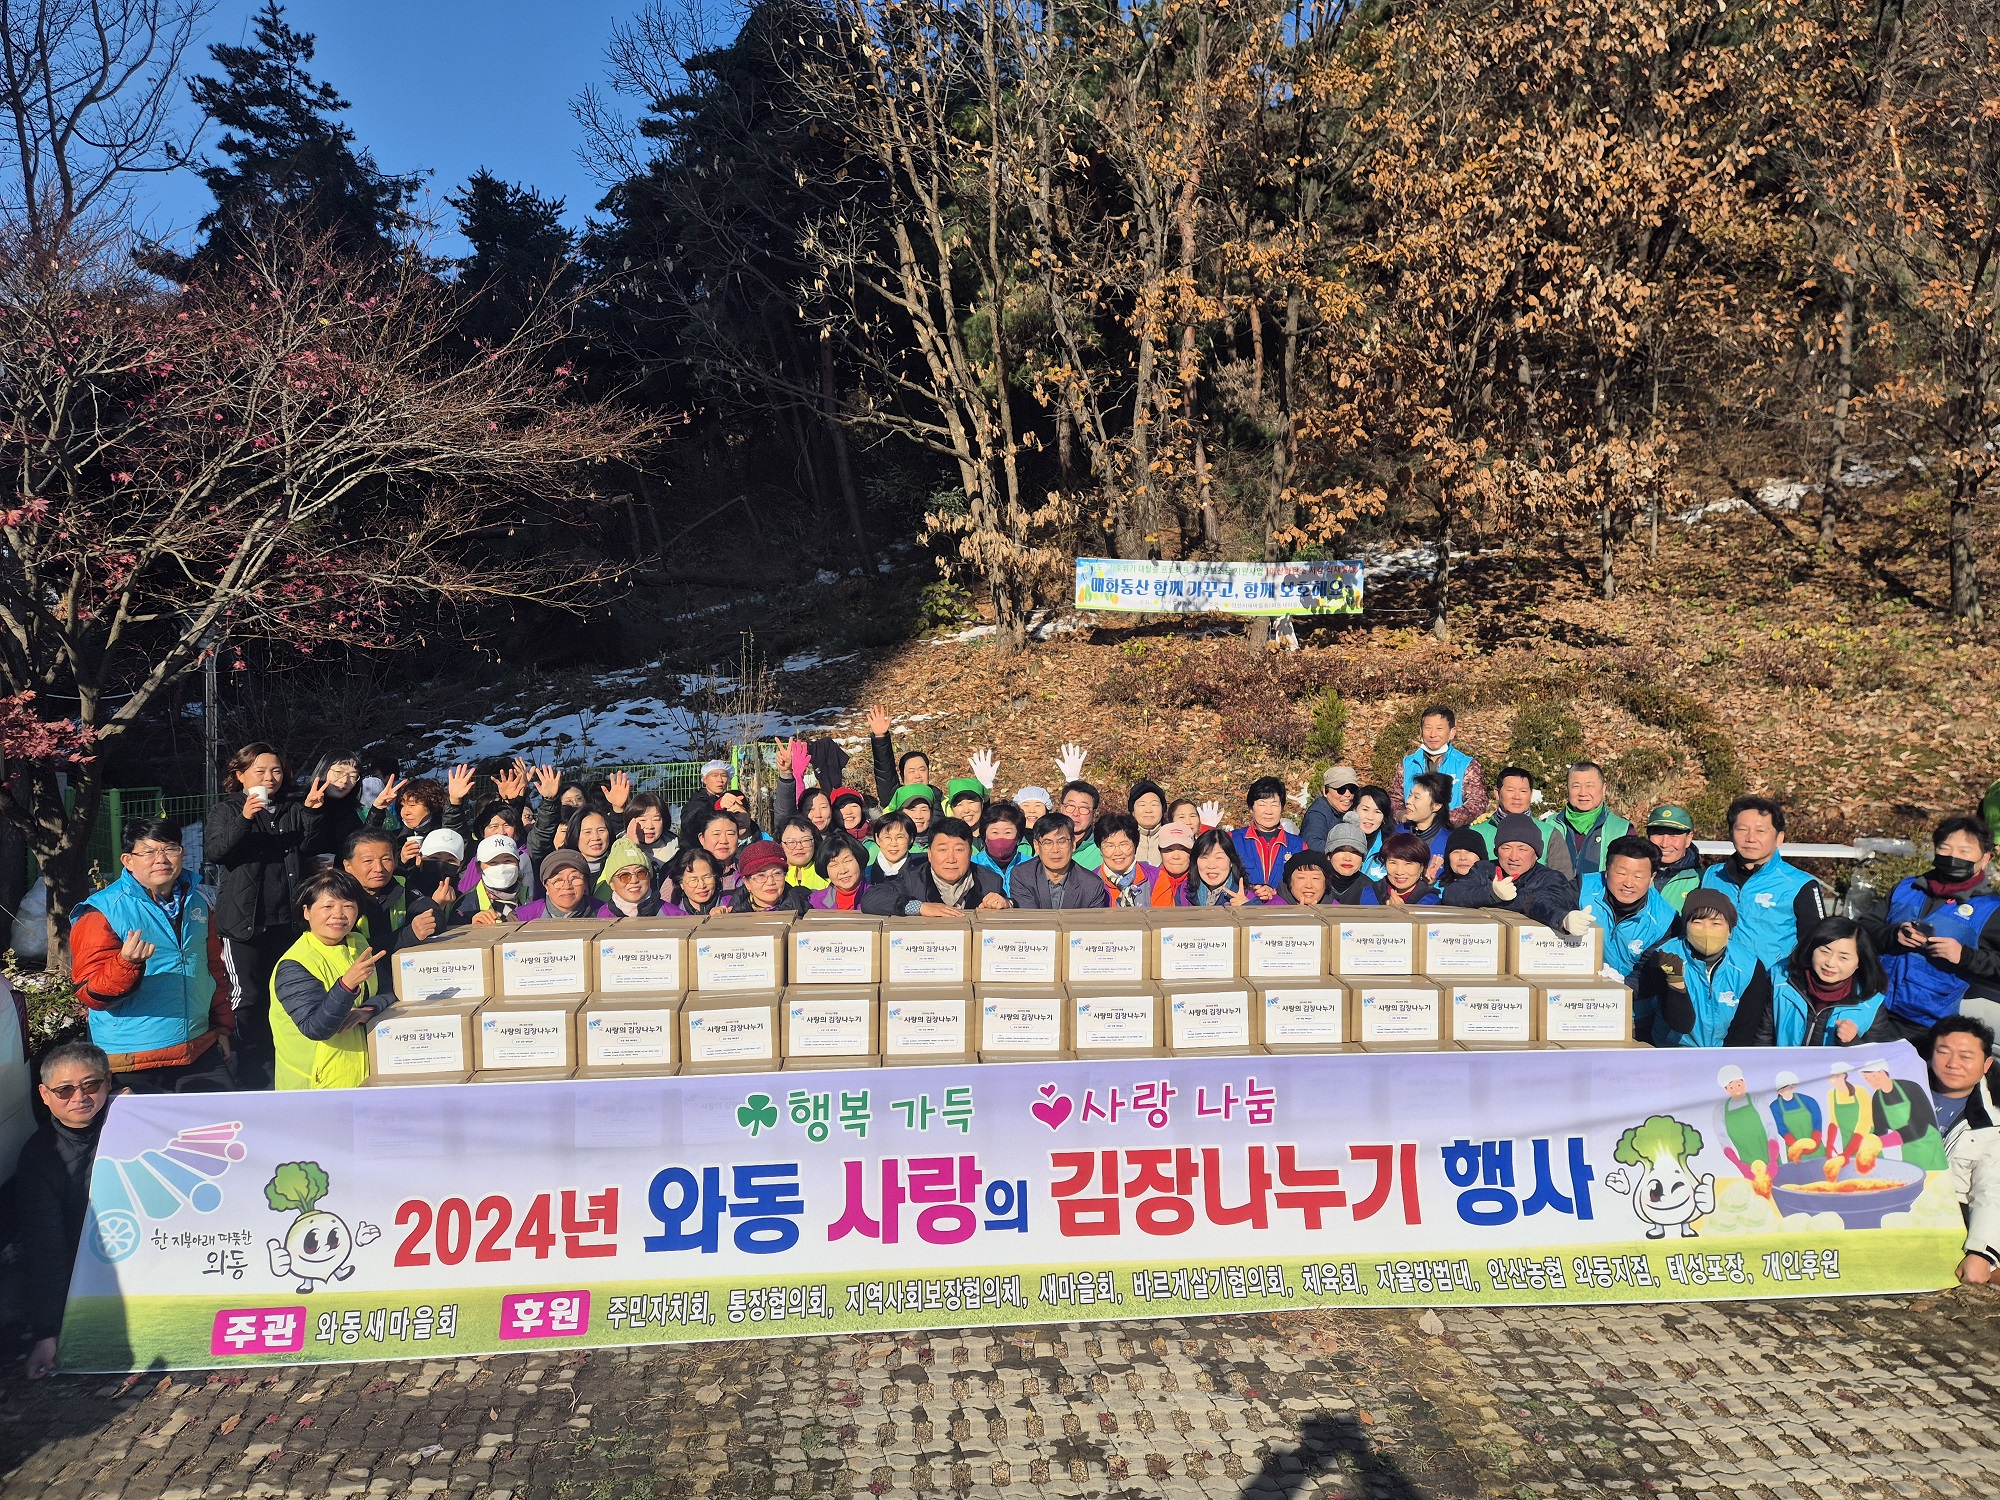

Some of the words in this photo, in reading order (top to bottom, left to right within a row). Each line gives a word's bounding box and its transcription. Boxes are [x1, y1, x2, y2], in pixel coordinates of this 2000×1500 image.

[1090, 577, 1150, 596] 매화동산
[1154, 580, 1183, 597] 함께
[1188, 580, 1238, 599] 가꾸고,
[1244, 581, 1275, 599] 함께
[788, 1090, 872, 1142] 행복
[891, 1087, 973, 1133] 가득
[1081, 1082, 1175, 1129] 사랑
[1197, 1079, 1275, 1124] 나눔
[394, 1188, 618, 1267] 2024년
[644, 1164, 803, 1254] 와동
[827, 1156, 1028, 1245] 사랑의
[1051, 1144, 1421, 1236] 김장나누기
[1441, 1137, 1595, 1226] 행사
[151, 1228, 168, 1250] 한
[218, 1229, 252, 1245] 따뜻한
[202, 1250, 248, 1280] 와동
[606, 1291, 716, 1330] 주민자치회,
[726, 1284, 835, 1324] 통장협의회,
[845, 1275, 1029, 1316] 지역사회보장협의체,
[1037, 1270, 1123, 1307] 새마을회,
[1133, 1264, 1294, 1304] 바르게살기협의회,
[1301, 1262, 1368, 1298] 체육회,
[1376, 1258, 1481, 1294] 자율방범대,
[1487, 1256, 1567, 1290] 안산농협
[1572, 1254, 1660, 1290] 와동지점,
[1669, 1252, 1754, 1286] 태성포장,
[1761, 1249, 1841, 1282] 개인후원
[224, 1314, 297, 1349] 주관
[317, 1304, 458, 1345] 와동새마을회
[512, 1297, 580, 1333] 후원
